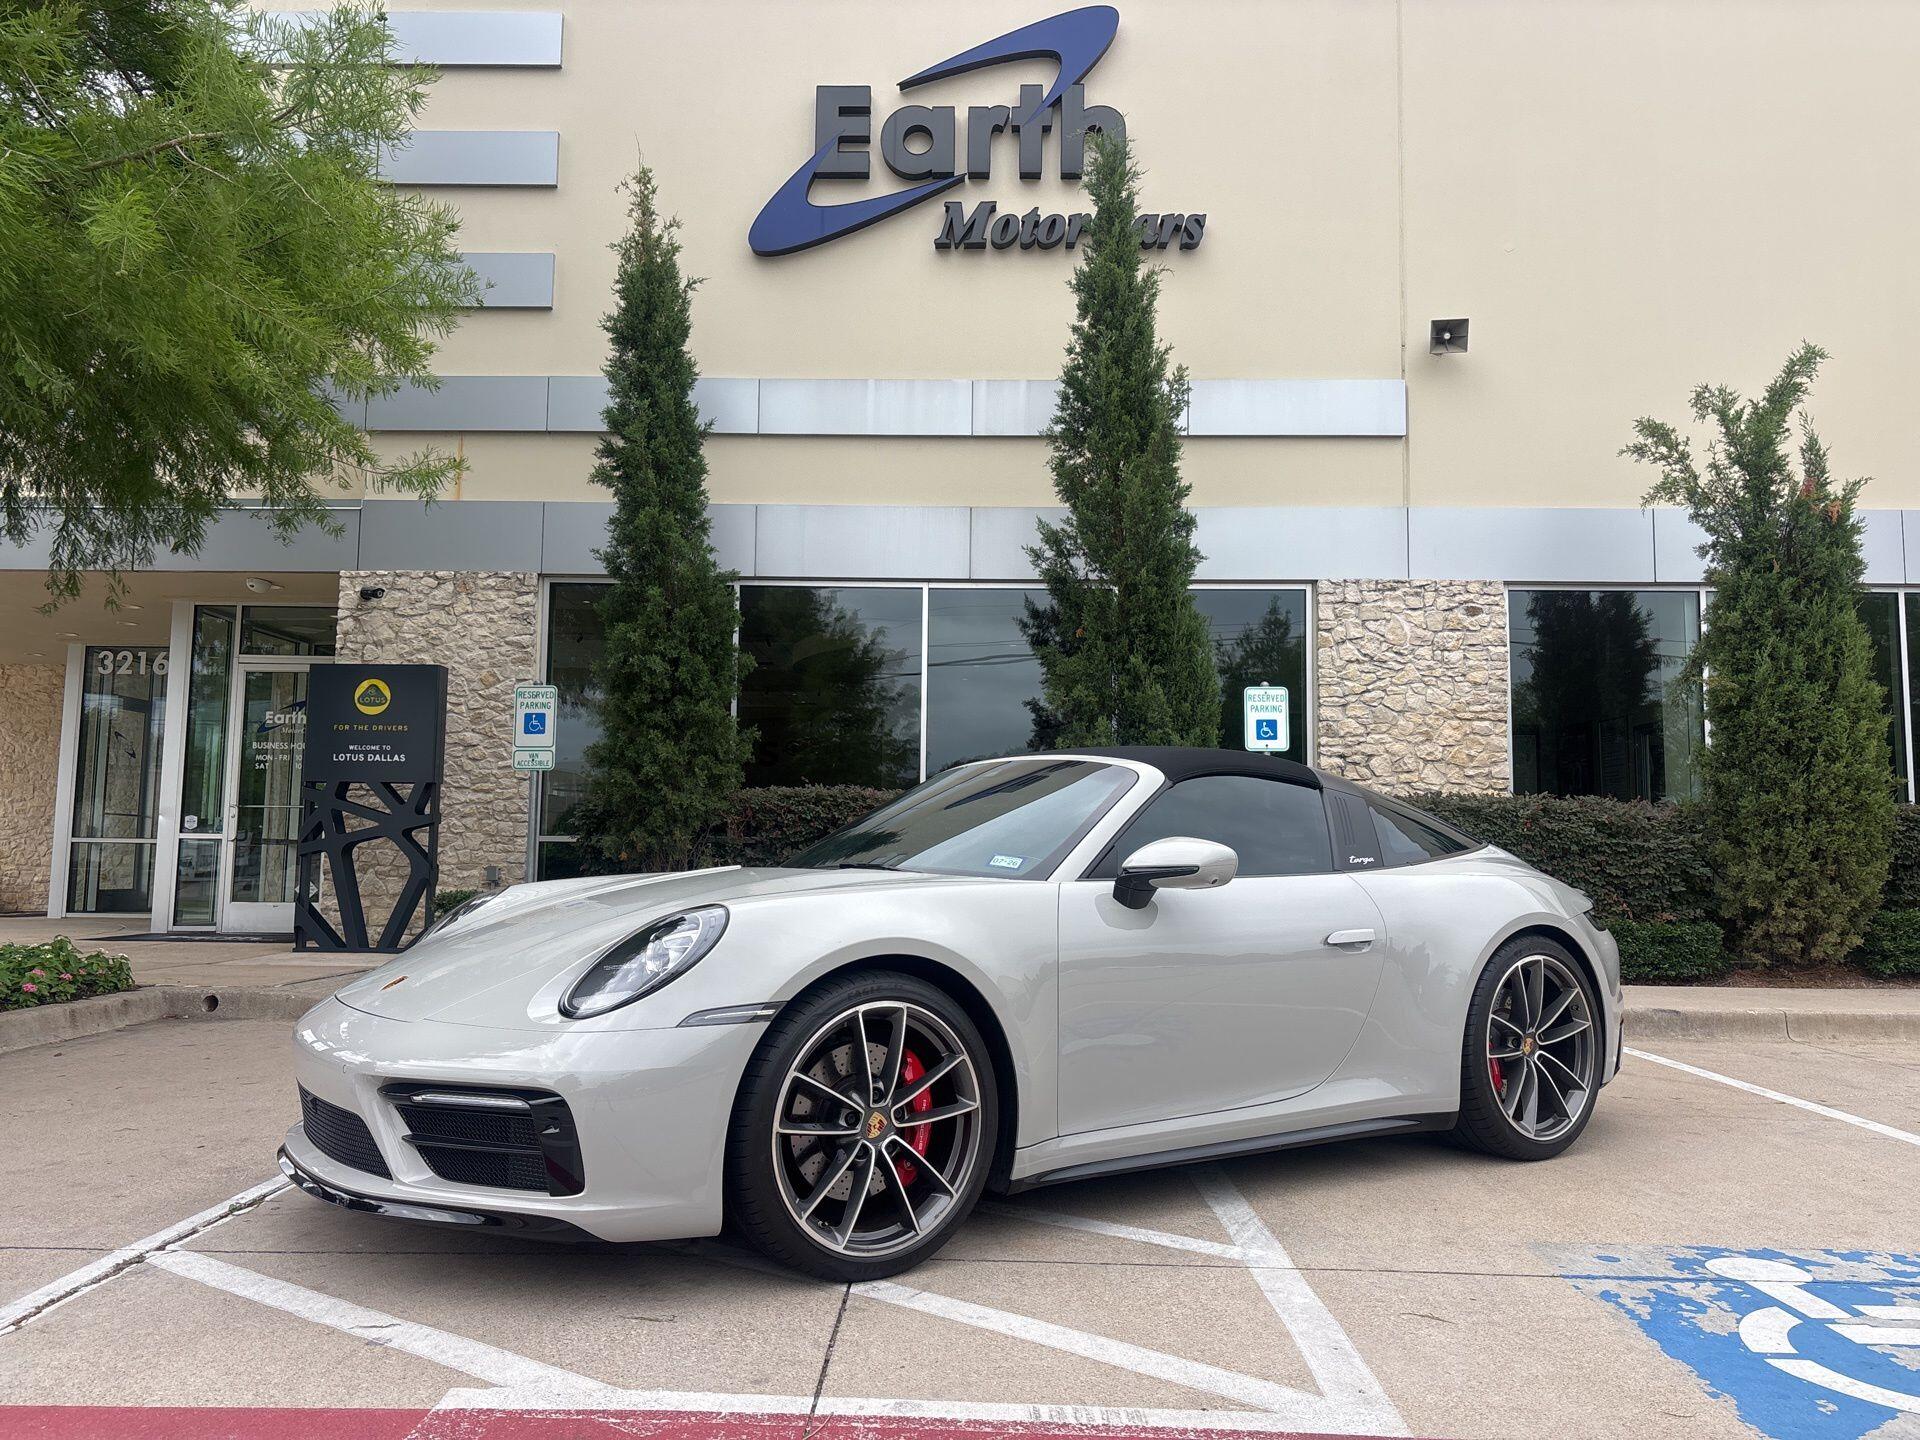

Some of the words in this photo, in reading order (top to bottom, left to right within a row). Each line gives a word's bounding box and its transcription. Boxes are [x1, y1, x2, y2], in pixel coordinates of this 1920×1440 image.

[814, 83, 1126, 180] Earth
[934, 200, 1207, 249] Motorars
[98, 650, 169, 675] 3216
[518, 690, 555, 699] RESERVED
[1248, 694, 1285, 702] RESERVED
[1250, 705, 1283, 713] PARKING
[265, 711, 307, 724] Earth
[372, 724, 408, 732] DRIVERS
[252, 741, 289, 750] BUSINESS
[333, 753, 365, 762] LOTUS
[367, 753, 406, 762] DALLAS
[254, 762, 269, 770] SAT
[295, 762, 303, 770] 10
